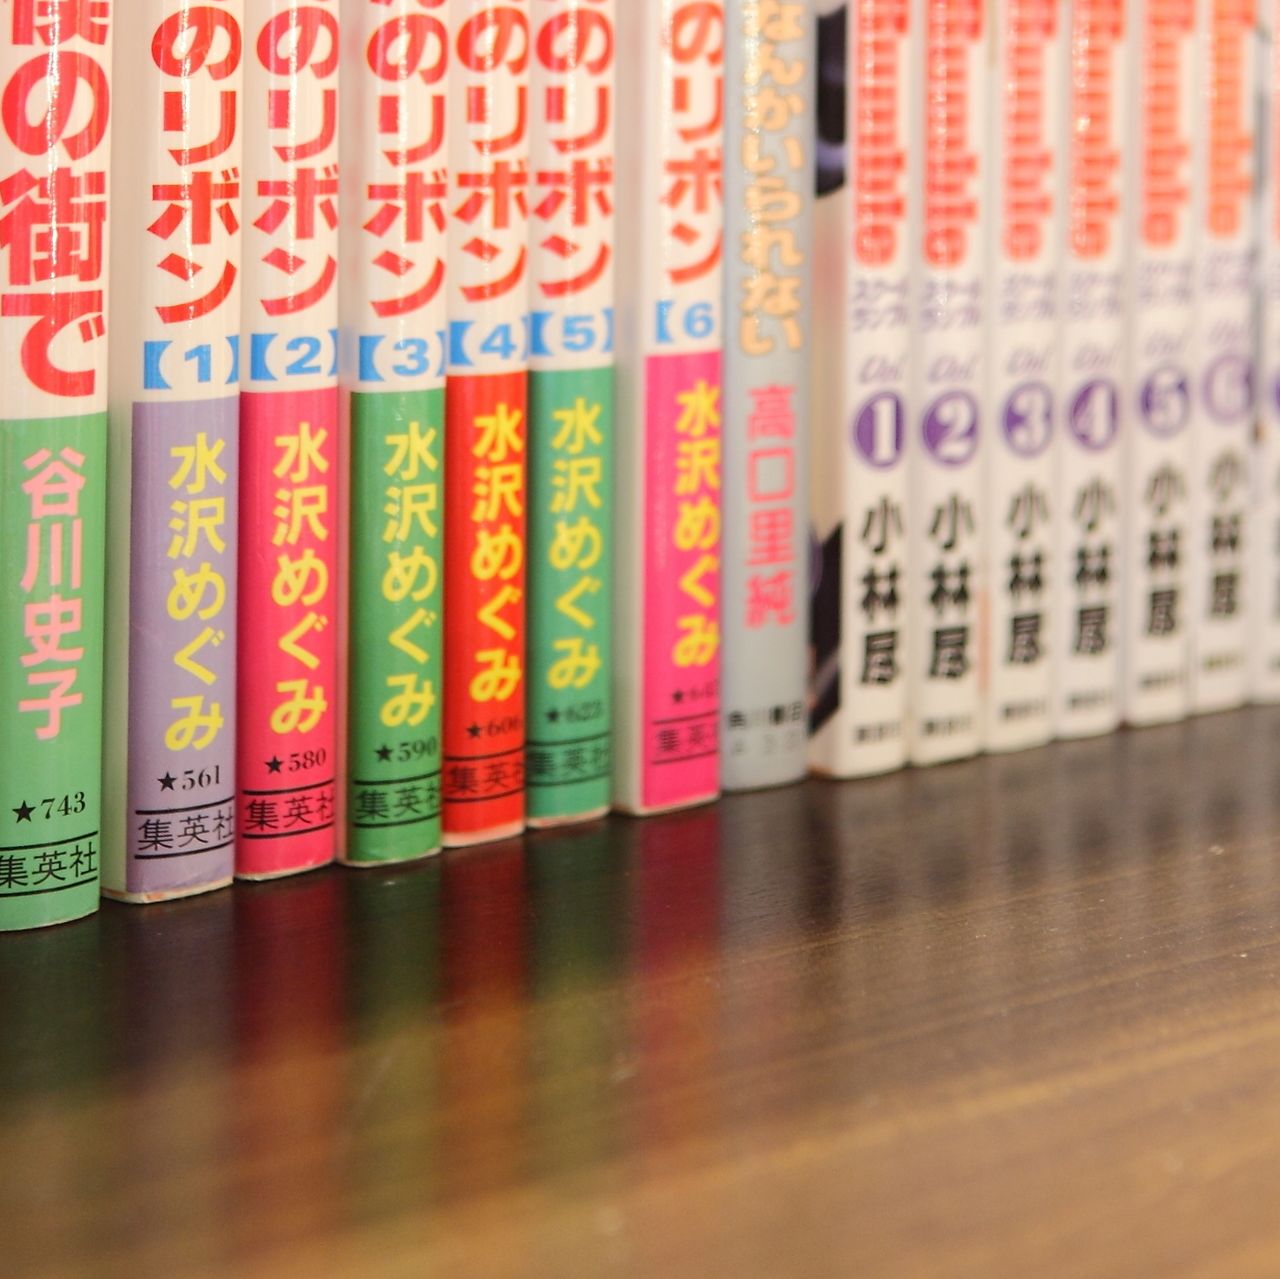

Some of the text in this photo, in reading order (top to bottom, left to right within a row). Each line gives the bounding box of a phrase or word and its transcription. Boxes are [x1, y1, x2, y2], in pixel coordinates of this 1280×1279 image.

[470, 403, 524, 701] 水沢めぐみ
[547, 397, 604, 690] 水沢めぐみ
[673, 379, 720, 667] 水沢めぐみ
[930, 392, 976, 466] 2
[1010, 383, 1052, 456] 3
[19, 447, 86, 741] 谷川史子
[164, 432, 228, 752] 水沢めぐみ
[269, 423, 329, 735] 水沢めぐみ
[380, 422, 438, 728] 水沢めぐみ
[42, 791, 87, 822] 743
[182, 765, 221, 791] 561
[288, 748, 326, 772] 580
